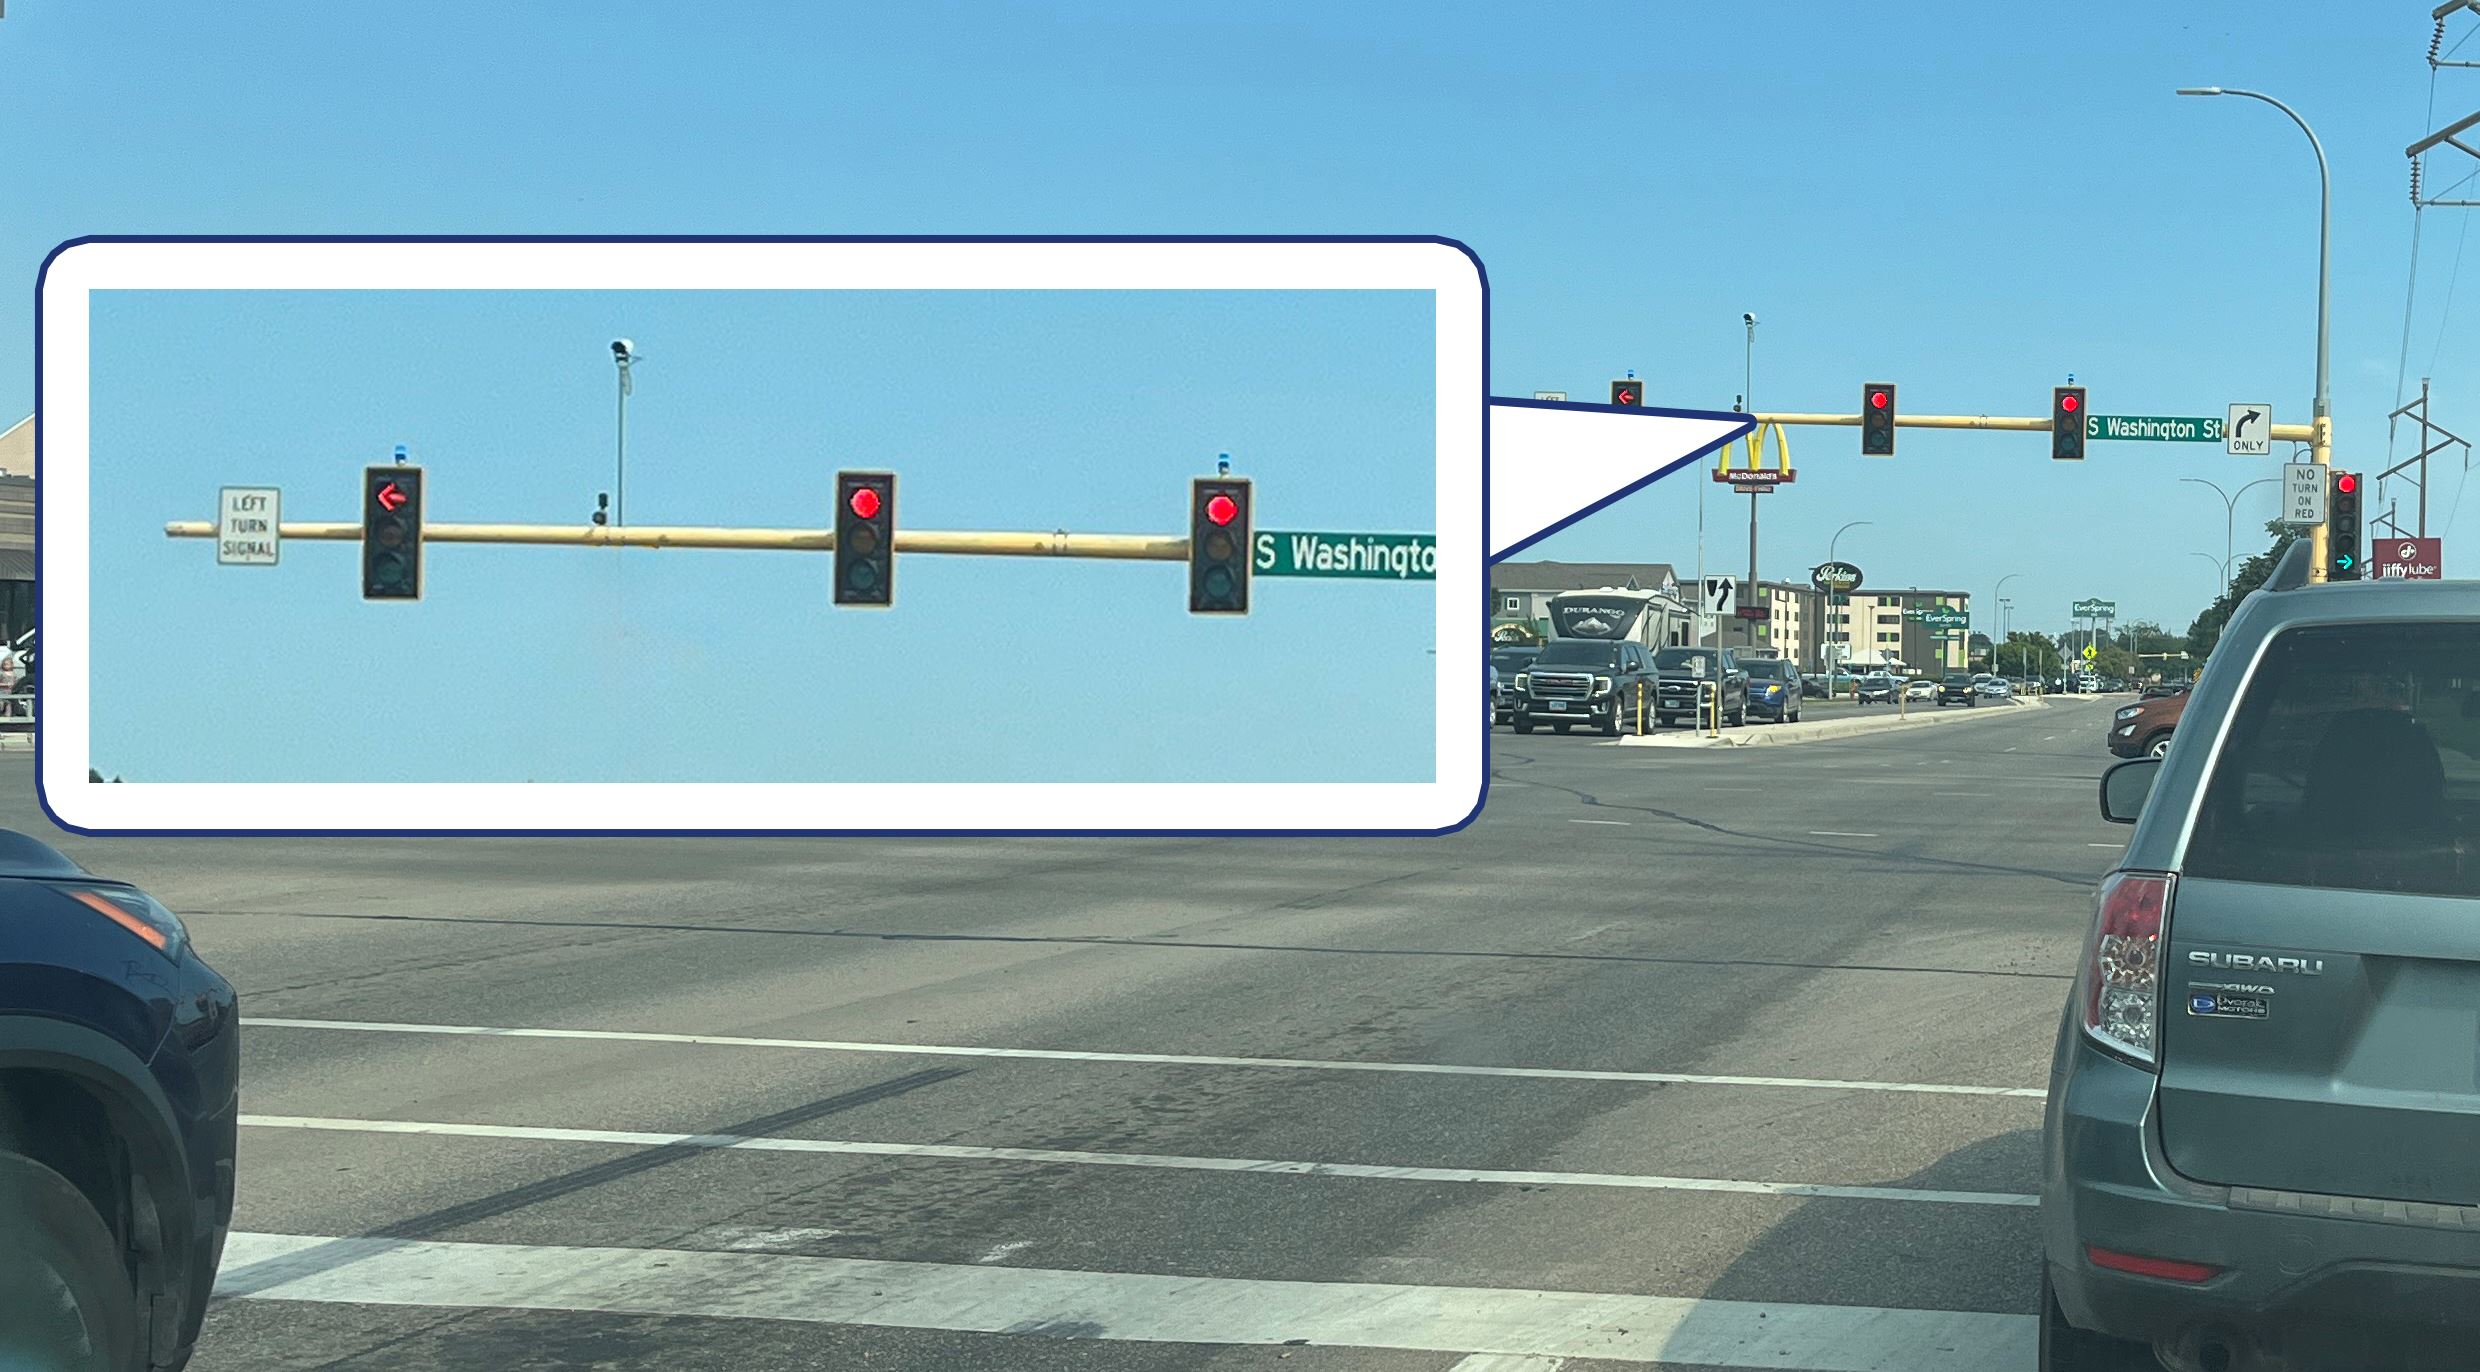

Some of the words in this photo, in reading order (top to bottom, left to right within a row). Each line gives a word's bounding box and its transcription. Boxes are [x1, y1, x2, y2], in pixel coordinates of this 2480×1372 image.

[2088, 417, 2099, 436] S
[2107, 417, 2195, 441] Washington
[2203, 419, 2221, 439] St
[2233, 440, 2264, 451] ONLY
[2296, 469, 2315, 480] NO
[2292, 483, 2318, 493] TURN
[232, 494, 267, 512] LEFT
[2298, 496, 2311, 506] ON
[2295, 508, 2314, 519] RED
[231, 519, 267, 533] TURN
[223, 540, 275, 557] SIGNAL
[1256, 534, 1275, 569] S
[2409, 563, 2434, 575] lube
[1562, 606, 1626, 619] DURANGO
[2074, 603, 2115, 614] EverSpring
[1925, 613, 1967, 624] EverSpring
[2188, 950, 2323, 976] SUBARU
